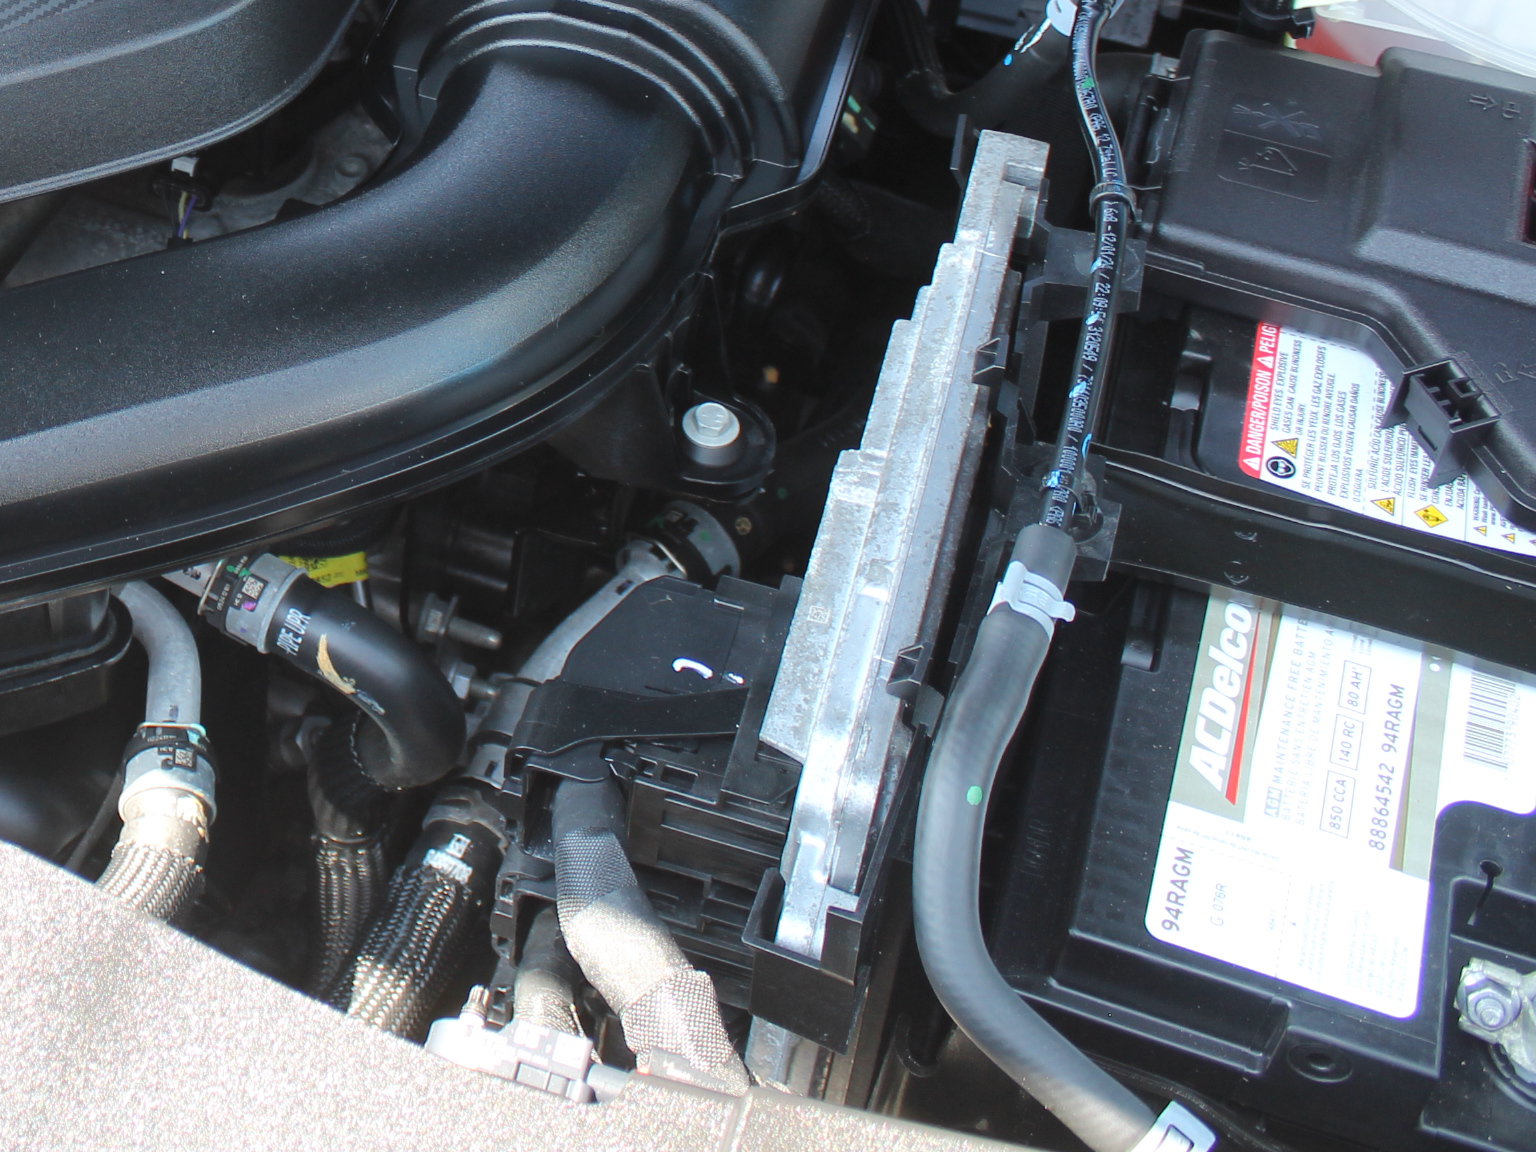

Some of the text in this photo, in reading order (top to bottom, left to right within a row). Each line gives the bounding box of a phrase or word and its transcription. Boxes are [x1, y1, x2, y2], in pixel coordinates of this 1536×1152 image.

[1312, 344, 1326, 380] EXPLOSIFS
[1269, 406, 1281, 431] SHIELD
[1275, 350, 1288, 386] EXPLOSIVE
[1281, 338, 1302, 434] GASES CAN CAUSE BLINDNESS
[1310, 394, 1320, 408] LES
[1311, 379, 1322, 394] GAZ
[1335, 389, 1347, 413] GASES
[1244, 368, 1273, 456] DANGER/POISON
[1321, 400, 1332, 425] RENDRE
[1333, 412, 1344, 427] LOS
[1305, 428, 1317, 442] LES
[1319, 425, 1329, 435] OU
[1339, 382, 1360, 499] EXPLOSIVOS PUEDEN CAUSAR DAÑOS
[1300, 442, 1315, 478] PROTÉGER
[1316, 435, 1328, 462] BLESSER
[1329, 448, 1340, 463] LOS
[1370, 438, 1381, 455] ACID
[1313, 463, 1325, 492] PEUVENT
[1326, 463, 1338, 495] PROTEJA
[1366, 454, 1379, 489] SULFURIC
[1408, 458, 1418, 474] EYES
[1300, 479, 1310, 489] SE
[1405, 476, 1417, 498] FLUSH
[1417, 493, 1427, 501] SE
[275, 608, 312, 656] PIPE UPR
[1285, 658, 1301, 691] FREE
[1184, 598, 1255, 792] ACDelco
[1346, 690, 1360, 707] 80
[1270, 693, 1296, 785] MAINTENANCE
[1338, 719, 1356, 763] 140 RC
[1367, 681, 1407, 851] 88864542 94RAGM
[1264, 786, 1283, 818] AGM
[1328, 776, 1347, 831] 850 CCA
[1154, 844, 1195, 933] 94RAGM
[1208, 914, 1225, 927] G
